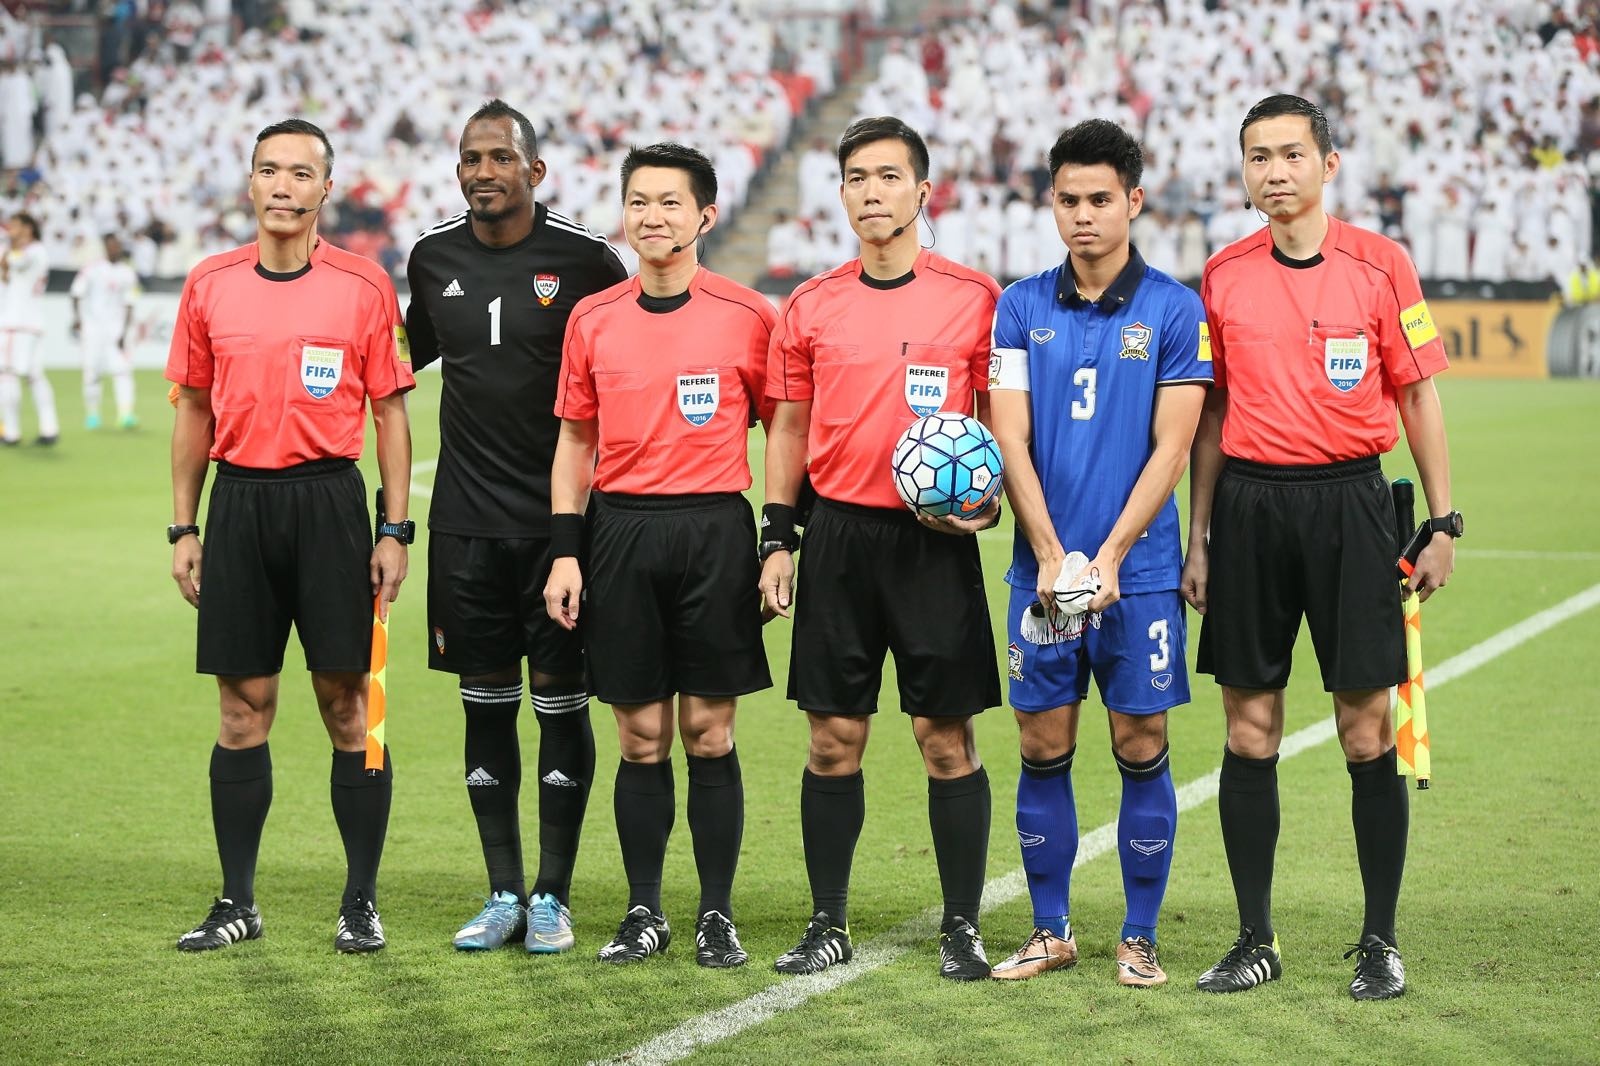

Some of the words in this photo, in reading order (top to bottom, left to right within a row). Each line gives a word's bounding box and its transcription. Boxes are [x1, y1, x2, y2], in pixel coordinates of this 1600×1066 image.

[488, 296, 502, 346] 1
[1406, 318, 1423, 330] FIFA
[308, 356, 336, 364] REFEREE
[1330, 358, 1362, 370] FIFA
[306, 366, 336, 378] FIFA
[909, 368, 946, 378] REFEREE
[680, 378, 716, 386] REFEREE
[910, 384, 942, 397] FIFA
[1071, 368, 1097, 420] 3
[683, 392, 714, 406] FIFA
[1148, 618, 1170, 672] 3
